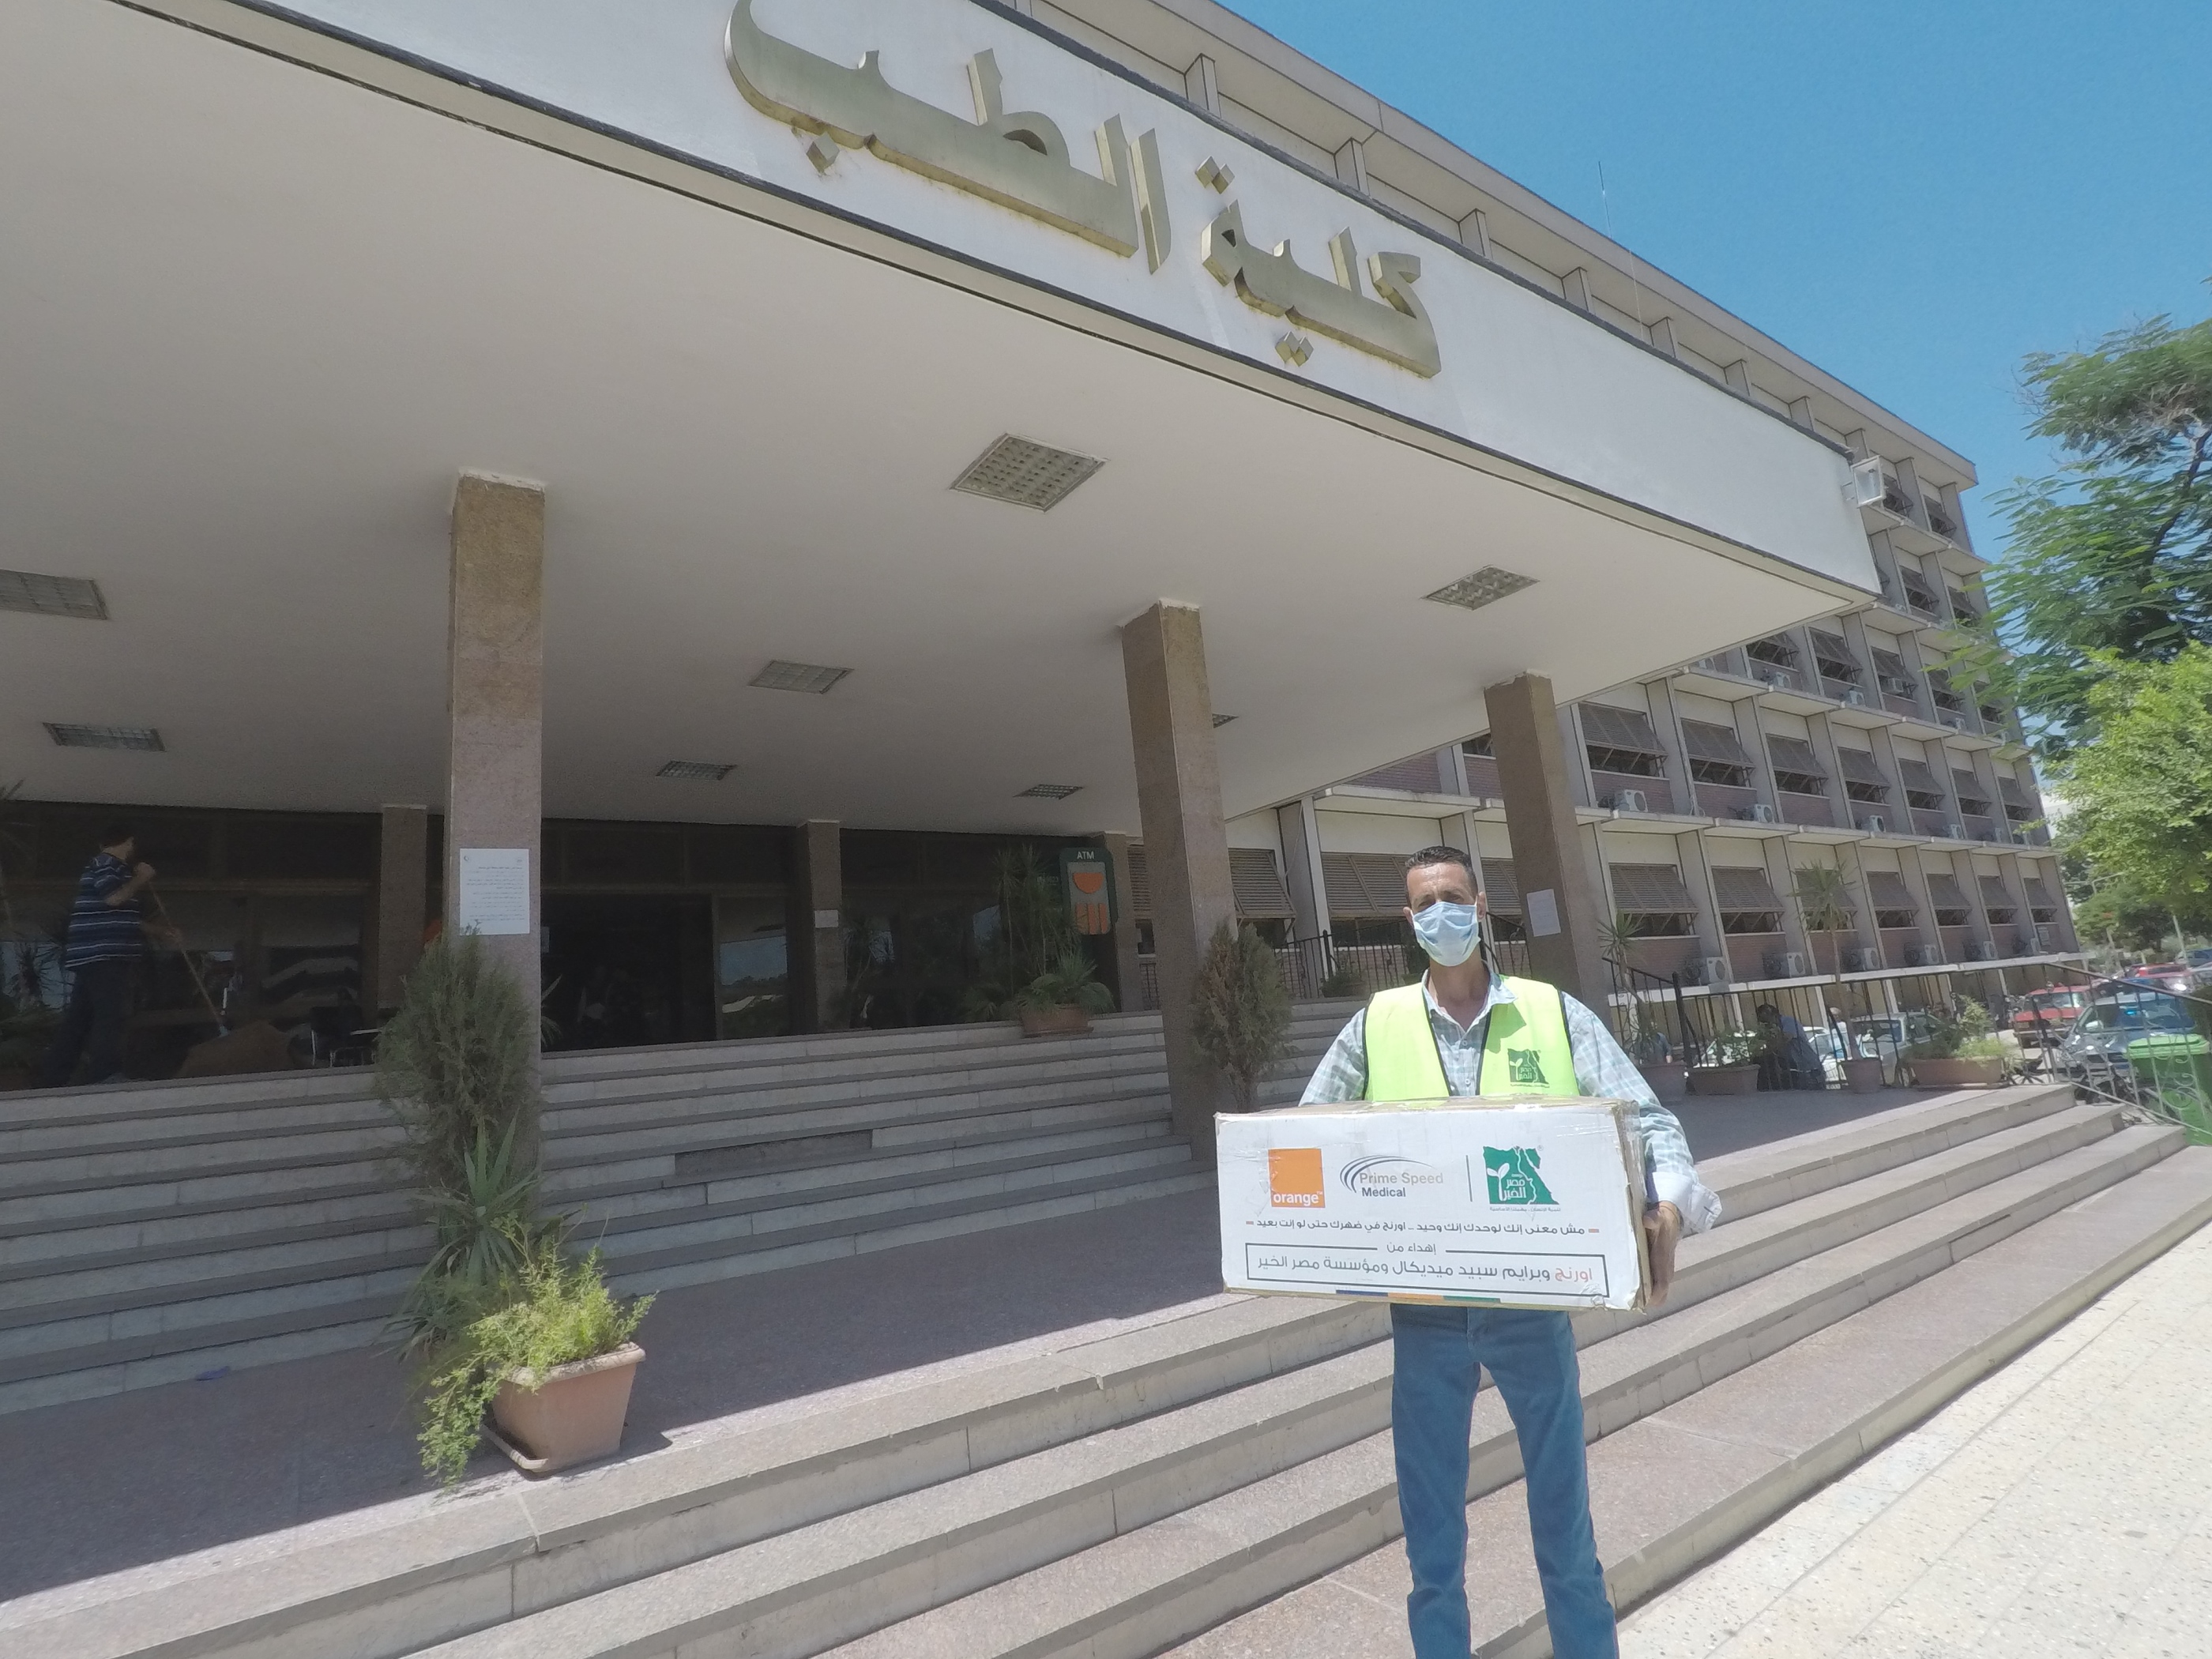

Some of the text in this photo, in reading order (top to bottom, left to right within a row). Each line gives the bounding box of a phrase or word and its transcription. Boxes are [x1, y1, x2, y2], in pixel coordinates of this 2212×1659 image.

[723, 0, 1442, 379] كلية الطب
[1076, 851, 1095, 860] ATM
[1359, 1172, 1444, 1186] Prime Speed
[1506, 1179, 1525, 1189] مصر
[1361, 1187, 1406, 1198] Medical
[1503, 1187, 1527, 1202] الخير
[1273, 1193, 1319, 1206] orange
[1256, 1219, 1278, 1228] بعيد
[1296, 1219, 1306, 1229] لو
[1307, 1219, 1328, 1229] حتى
[1330, 1220, 1363, 1230] ضهرك
[1364, 1221, 1381, 1233] في
[1416, 1223, 1443, 1233] وحيد
[1443, 1222, 1462, 1233] إنك
[1463, 1223, 1502, 1234] لوحدك
[1503, 1223, 1523, 1235] إنك
[1559, 1222, 1586, 1236] مش
[1525, 1224, 1558, 1235] معنى
[1386, 1242, 1437, 1255] إهداء من
[1258, 1255, 1593, 1283] اورنج وبرايم سبيد ميديكال ومؤسسة مصر الخير
